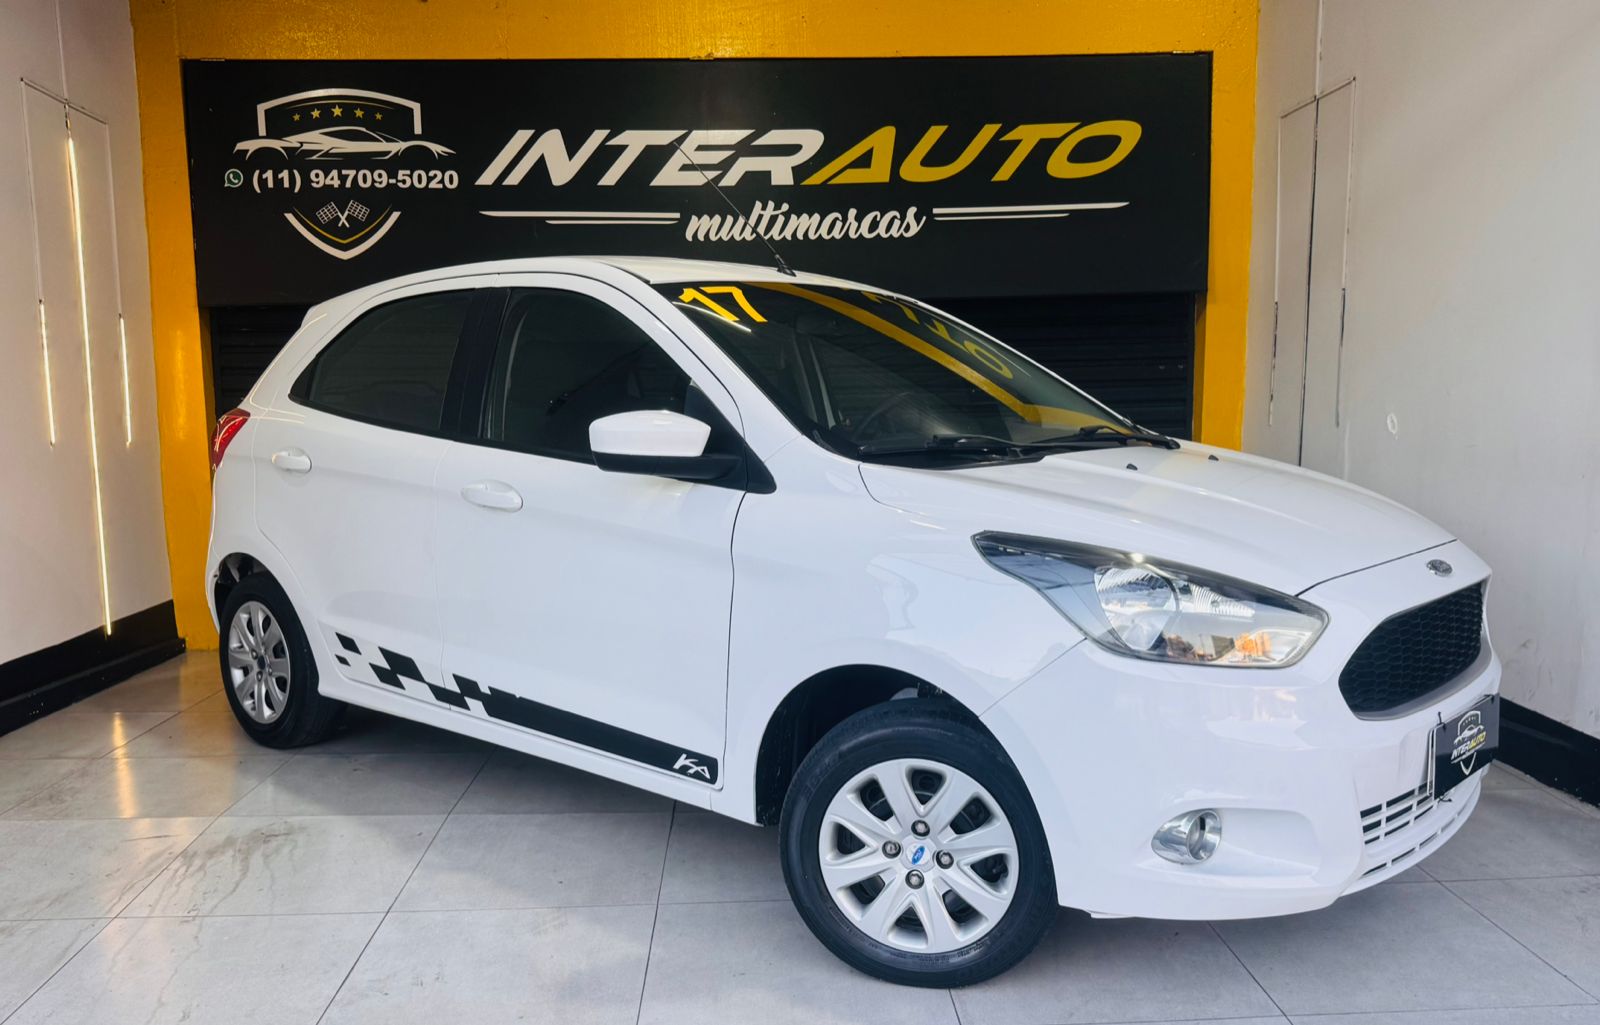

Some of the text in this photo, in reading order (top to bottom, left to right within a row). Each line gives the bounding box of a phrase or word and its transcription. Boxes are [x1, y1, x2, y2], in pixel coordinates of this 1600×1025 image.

[252, 169, 459, 193] (11) 94709-5020
[685, 199, 927, 242] multimarcas
